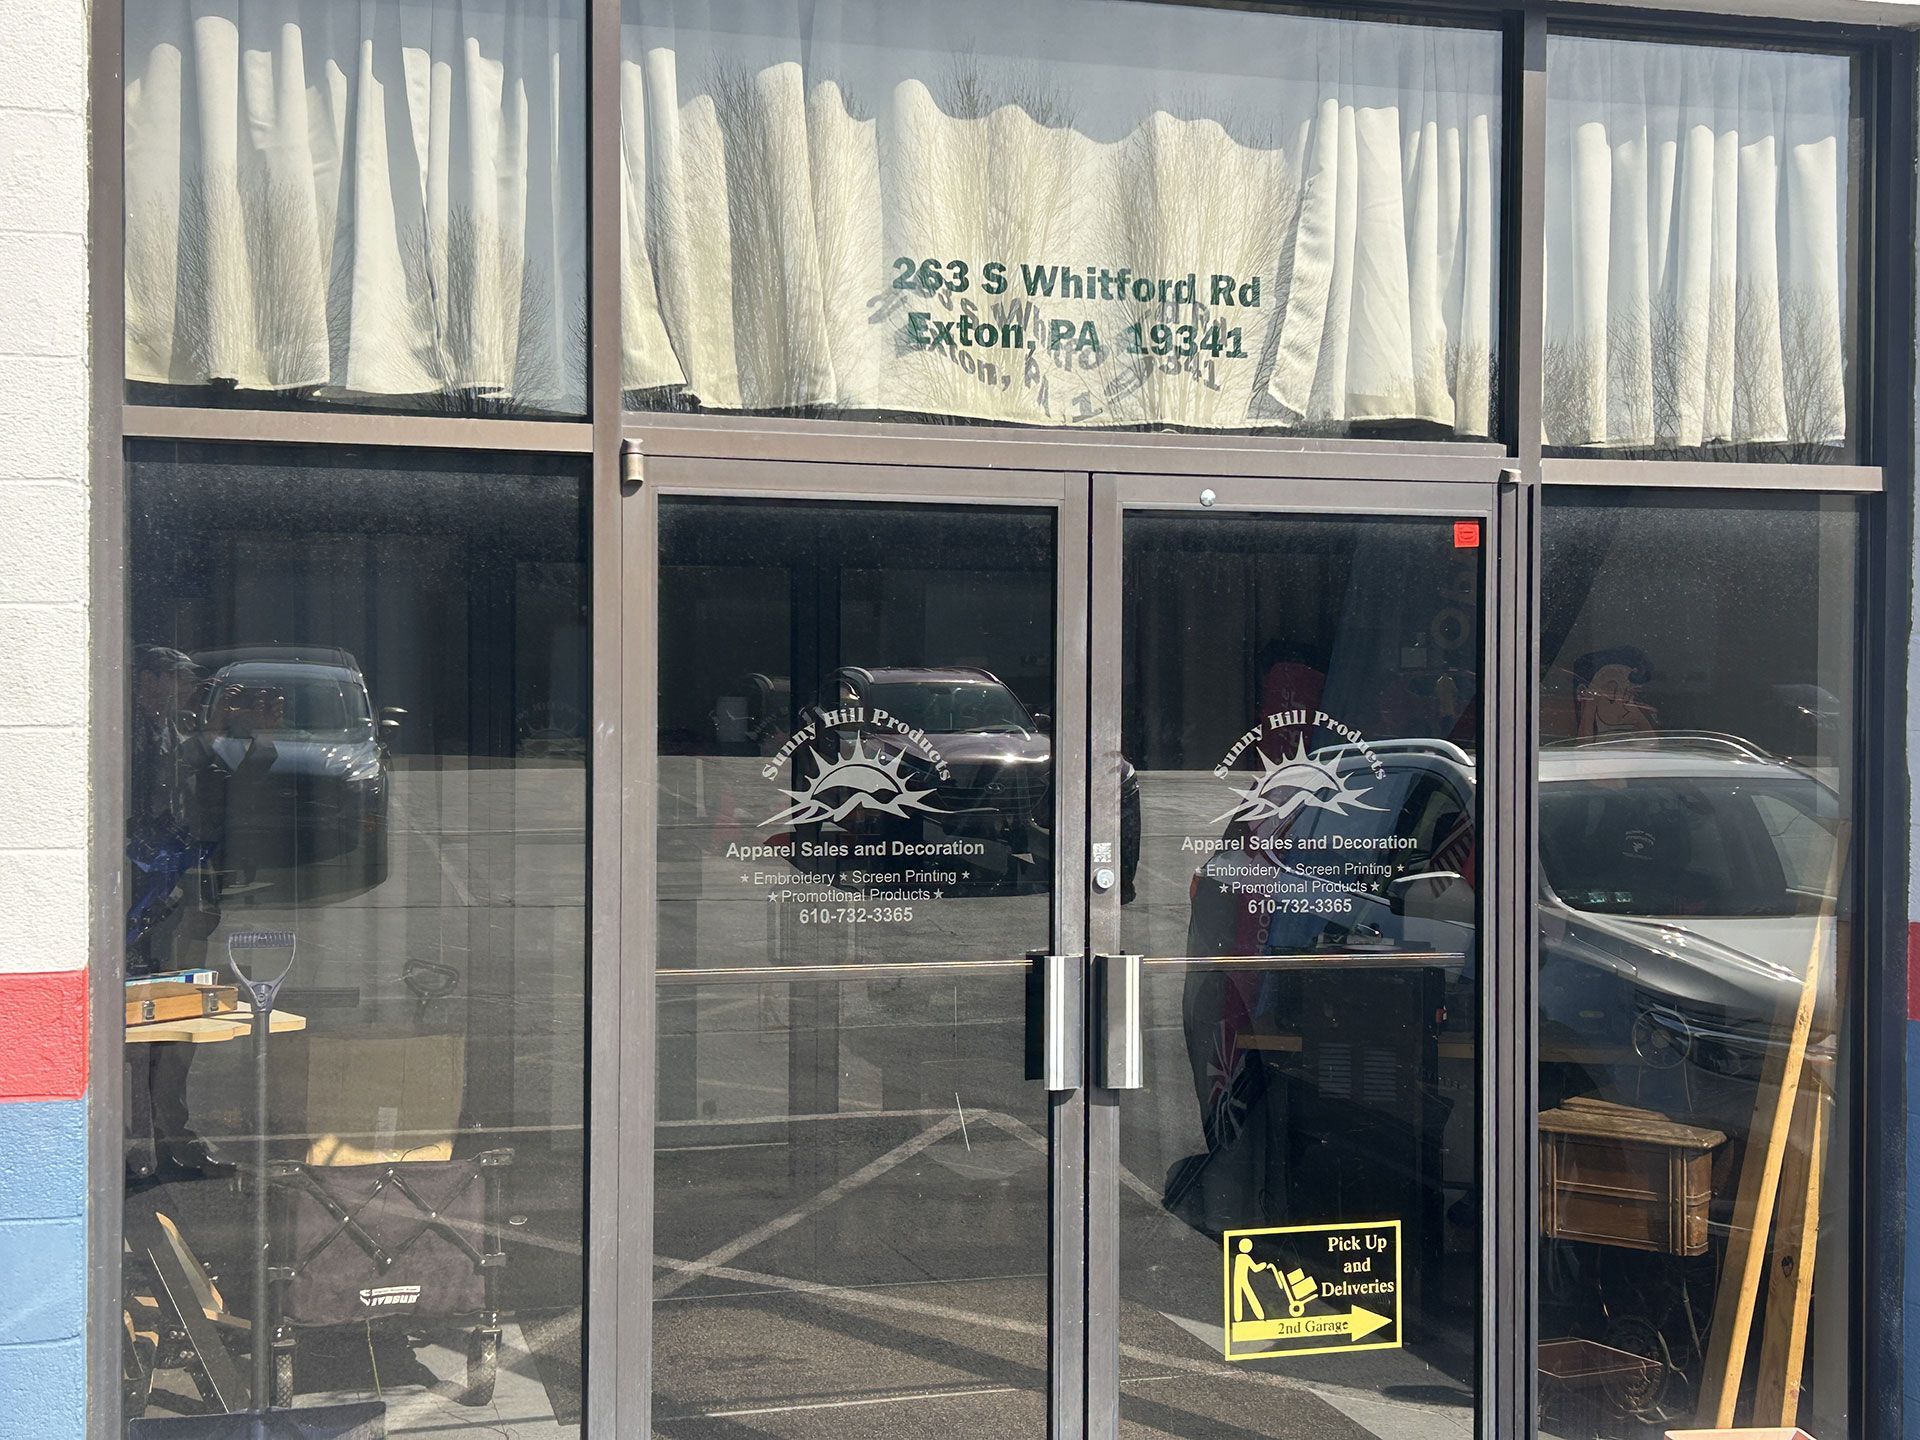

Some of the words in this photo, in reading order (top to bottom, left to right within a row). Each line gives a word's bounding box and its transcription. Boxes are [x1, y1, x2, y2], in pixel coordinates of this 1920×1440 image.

[892, 257, 969, 298] 263
[982, 261, 1008, 295] S
[1020, 264, 1196, 305] Whitford
[1210, 274, 1261, 308] Rd
[907, 311, 1036, 350] Exton,
[1050, 319, 1100, 353] PA
[1126, 321, 1248, 359] 19341
[762, 722, 817, 781] Sunny
[823, 707, 865, 729] Hill
[871, 708, 951, 781] Products
[1213, 724, 1264, 780] Sunny
[1267, 709, 1307, 730] Hill
[1312, 710, 1387, 780] Products
[726, 842, 796, 860] Apparel
[800, 841, 849, 857] Sales
[854, 841, 887, 857] and
[891, 840, 985, 856] Decoration
[1181, 836, 1245, 854] Apparel
[1249, 835, 1293, 851] Sales
[1297, 835, 1327, 850] and
[1332, 834, 1418, 850] Decoration
[753, 871, 835, 887] Embroidery
[852, 870, 901, 884] Screen
[905, 869, 957, 886] Printing
[1206, 864, 1280, 879] Embroidery
[1295, 863, 1340, 877] Screen
[1344, 862, 1393, 878] Printing
[781, 888, 865, 903] Promotional
[869, 888, 931, 902] Products
[1231, 881, 1308, 894] Promotional
[1312, 880, 1368, 893] Products
[799, 907, 914, 924] 610-732-3365
[1247, 899, 1352, 914] 610-732-3365
[1327, 1235, 1361, 1252] Pick
[1365, 1234, 1388, 1253] Up
[1343, 1257, 1371, 1274] and
[1321, 1279, 1395, 1298] Deliveries
[1278, 1321, 1301, 1335] 2nd
[1305, 1319, 1349, 1333] Garage
